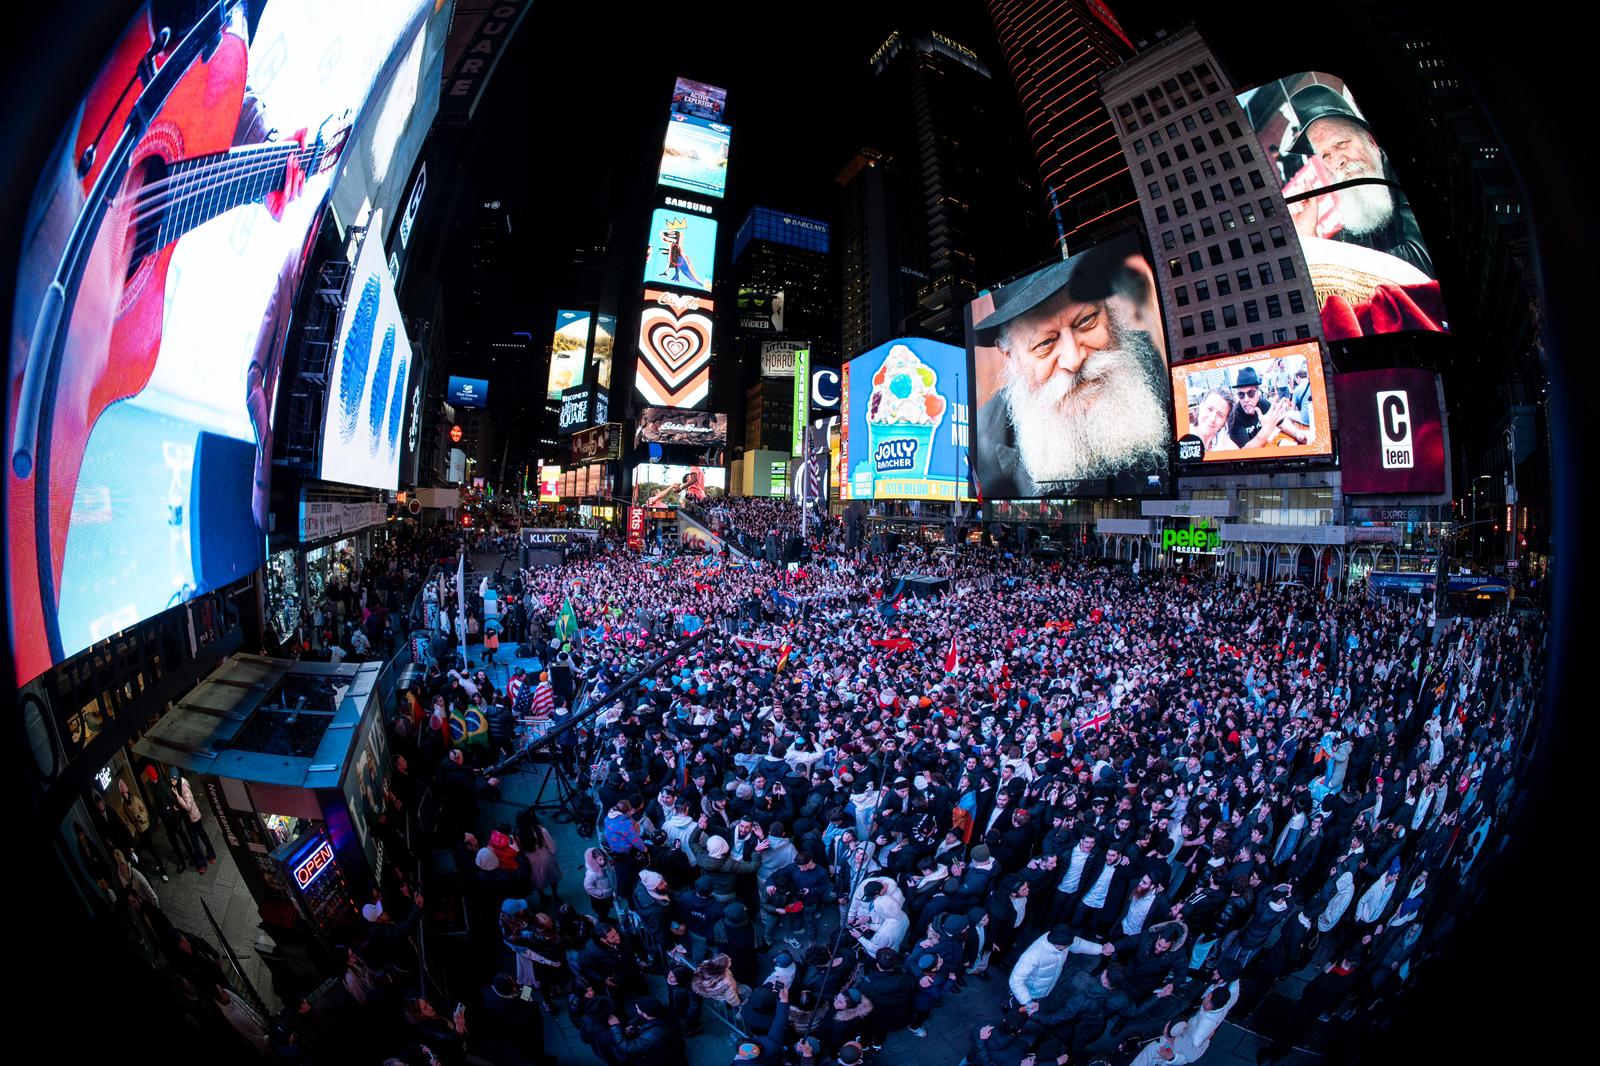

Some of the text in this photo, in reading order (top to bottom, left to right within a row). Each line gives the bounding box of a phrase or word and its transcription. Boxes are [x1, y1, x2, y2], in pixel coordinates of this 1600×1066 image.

[449, 0, 516, 95] QUARE
[684, 95, 714, 108] EXPERTISE
[665, 197, 712, 214] SAMSUNG
[792, 219, 826, 232] BARCLAYS
[740, 318, 769, 329] WICKED
[766, 342, 787, 352] LITTLE
[1216, 352, 1270, 367] CONGRATULATIONS
[797, 365, 805, 440] CANNABIS
[560, 409, 587, 427] SQUARE
[1382, 395, 1408, 443] C
[875, 441, 916, 461] JOLLY
[1386, 447, 1410, 466] teen
[877, 459, 912, 469] RANCHER
[632, 508, 643, 530] tkts
[530, 534, 567, 543] KLIKTIX
[1163, 520, 1208, 551] pelé
[298, 845, 331, 884] OPEN
